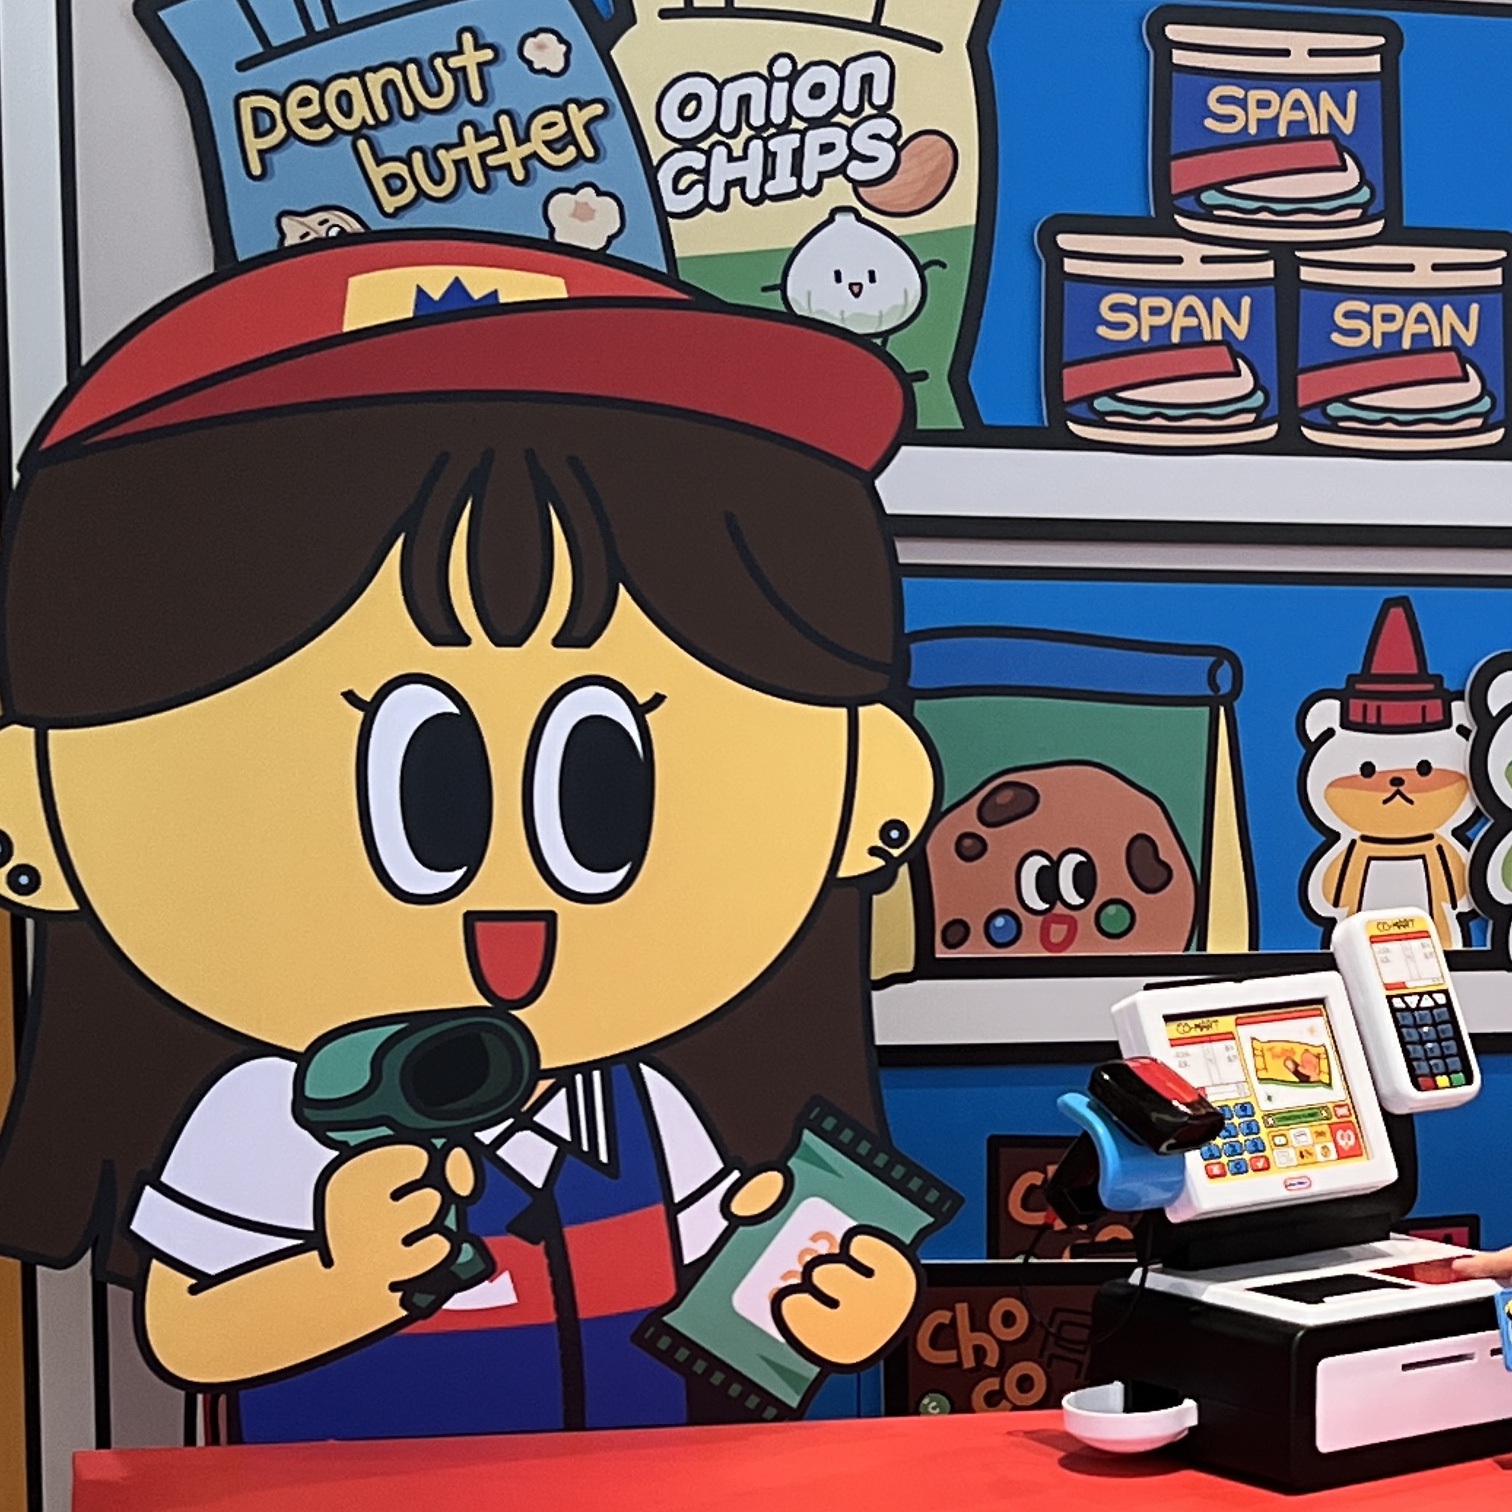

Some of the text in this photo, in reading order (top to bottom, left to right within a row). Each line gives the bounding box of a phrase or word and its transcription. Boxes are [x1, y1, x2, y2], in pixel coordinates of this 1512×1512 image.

[235, 27, 499, 179] peanut
[1204, 85, 1358, 137] SPAN
[354, 96, 606, 215] butter
[656, 113, 900, 216] CHIPS
[1096, 293, 1251, 344] SPAN
[1330, 301, 1479, 349] SPAN
